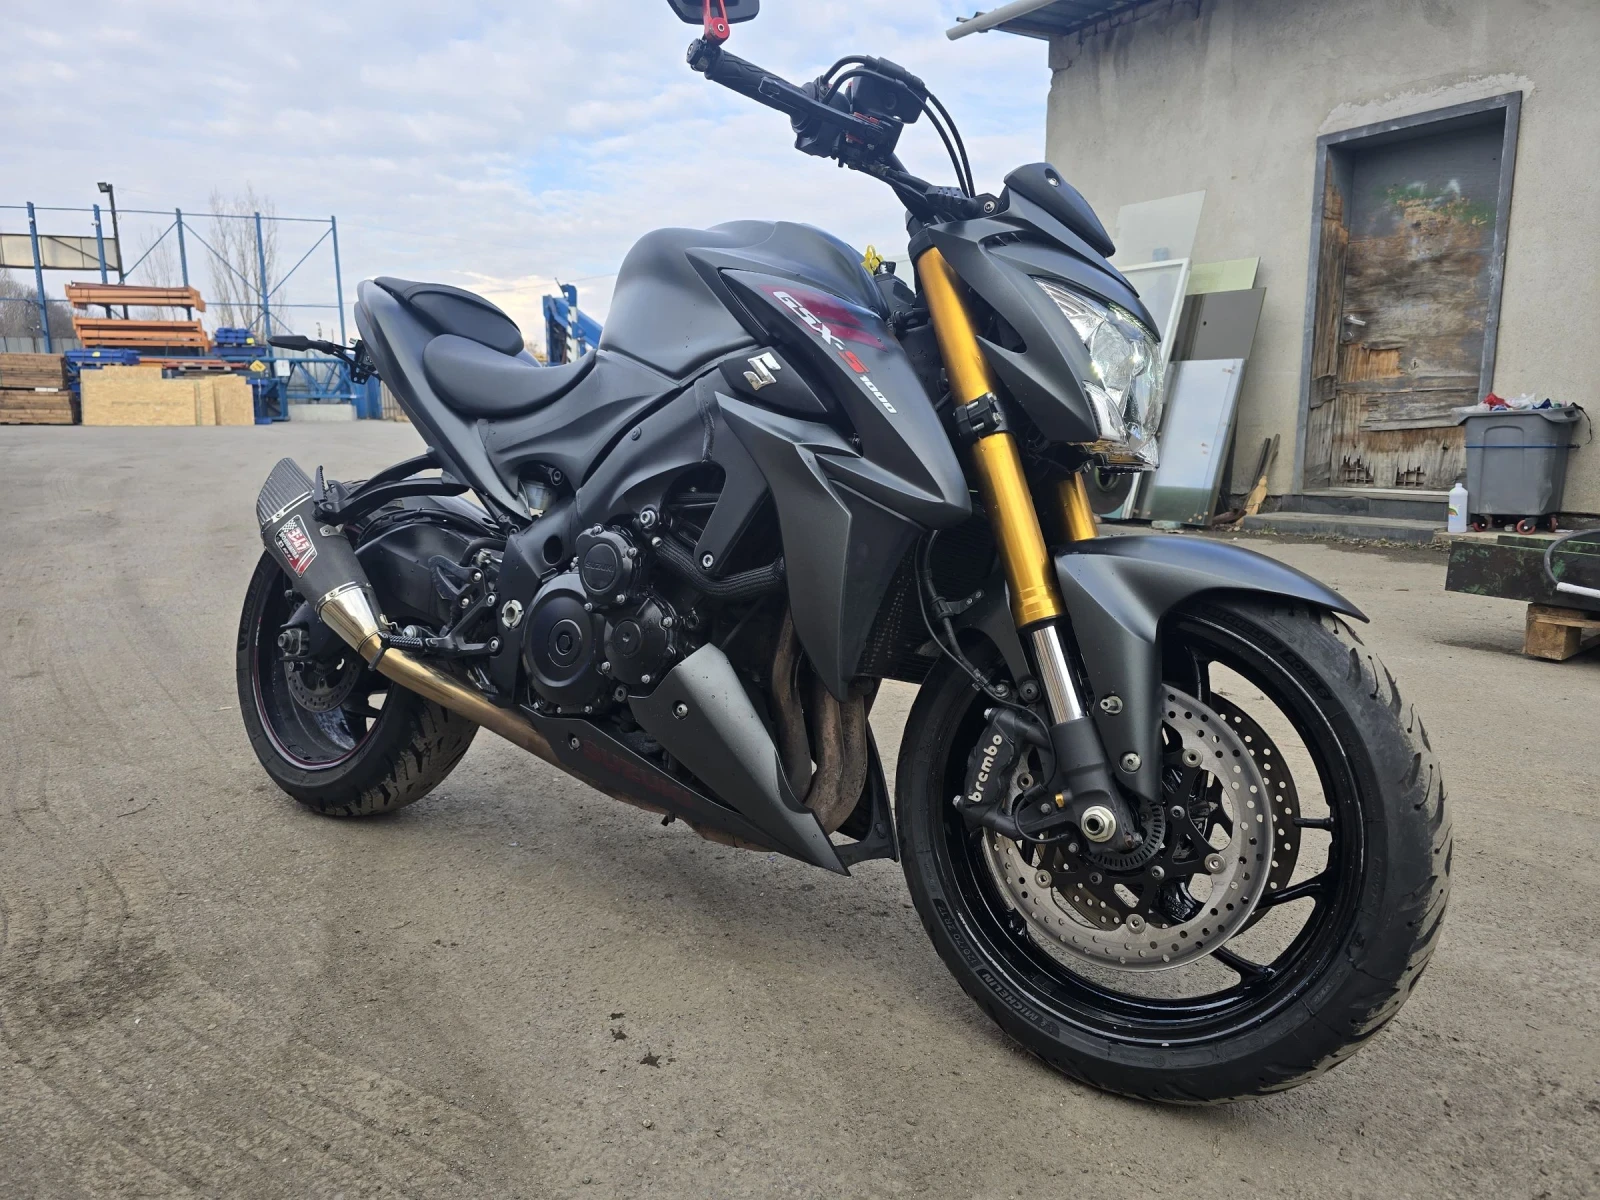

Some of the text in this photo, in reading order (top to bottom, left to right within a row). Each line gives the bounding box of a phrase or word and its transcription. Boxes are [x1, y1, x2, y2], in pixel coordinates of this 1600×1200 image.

[773, 291, 897, 414] GSX-S 1000
[584, 561, 615, 573] SUZUKI
[1285, 653, 1330, 701] ROAD 6
[968, 734, 1003, 803] brembo
[981, 972, 1040, 1022] MICHELIN
